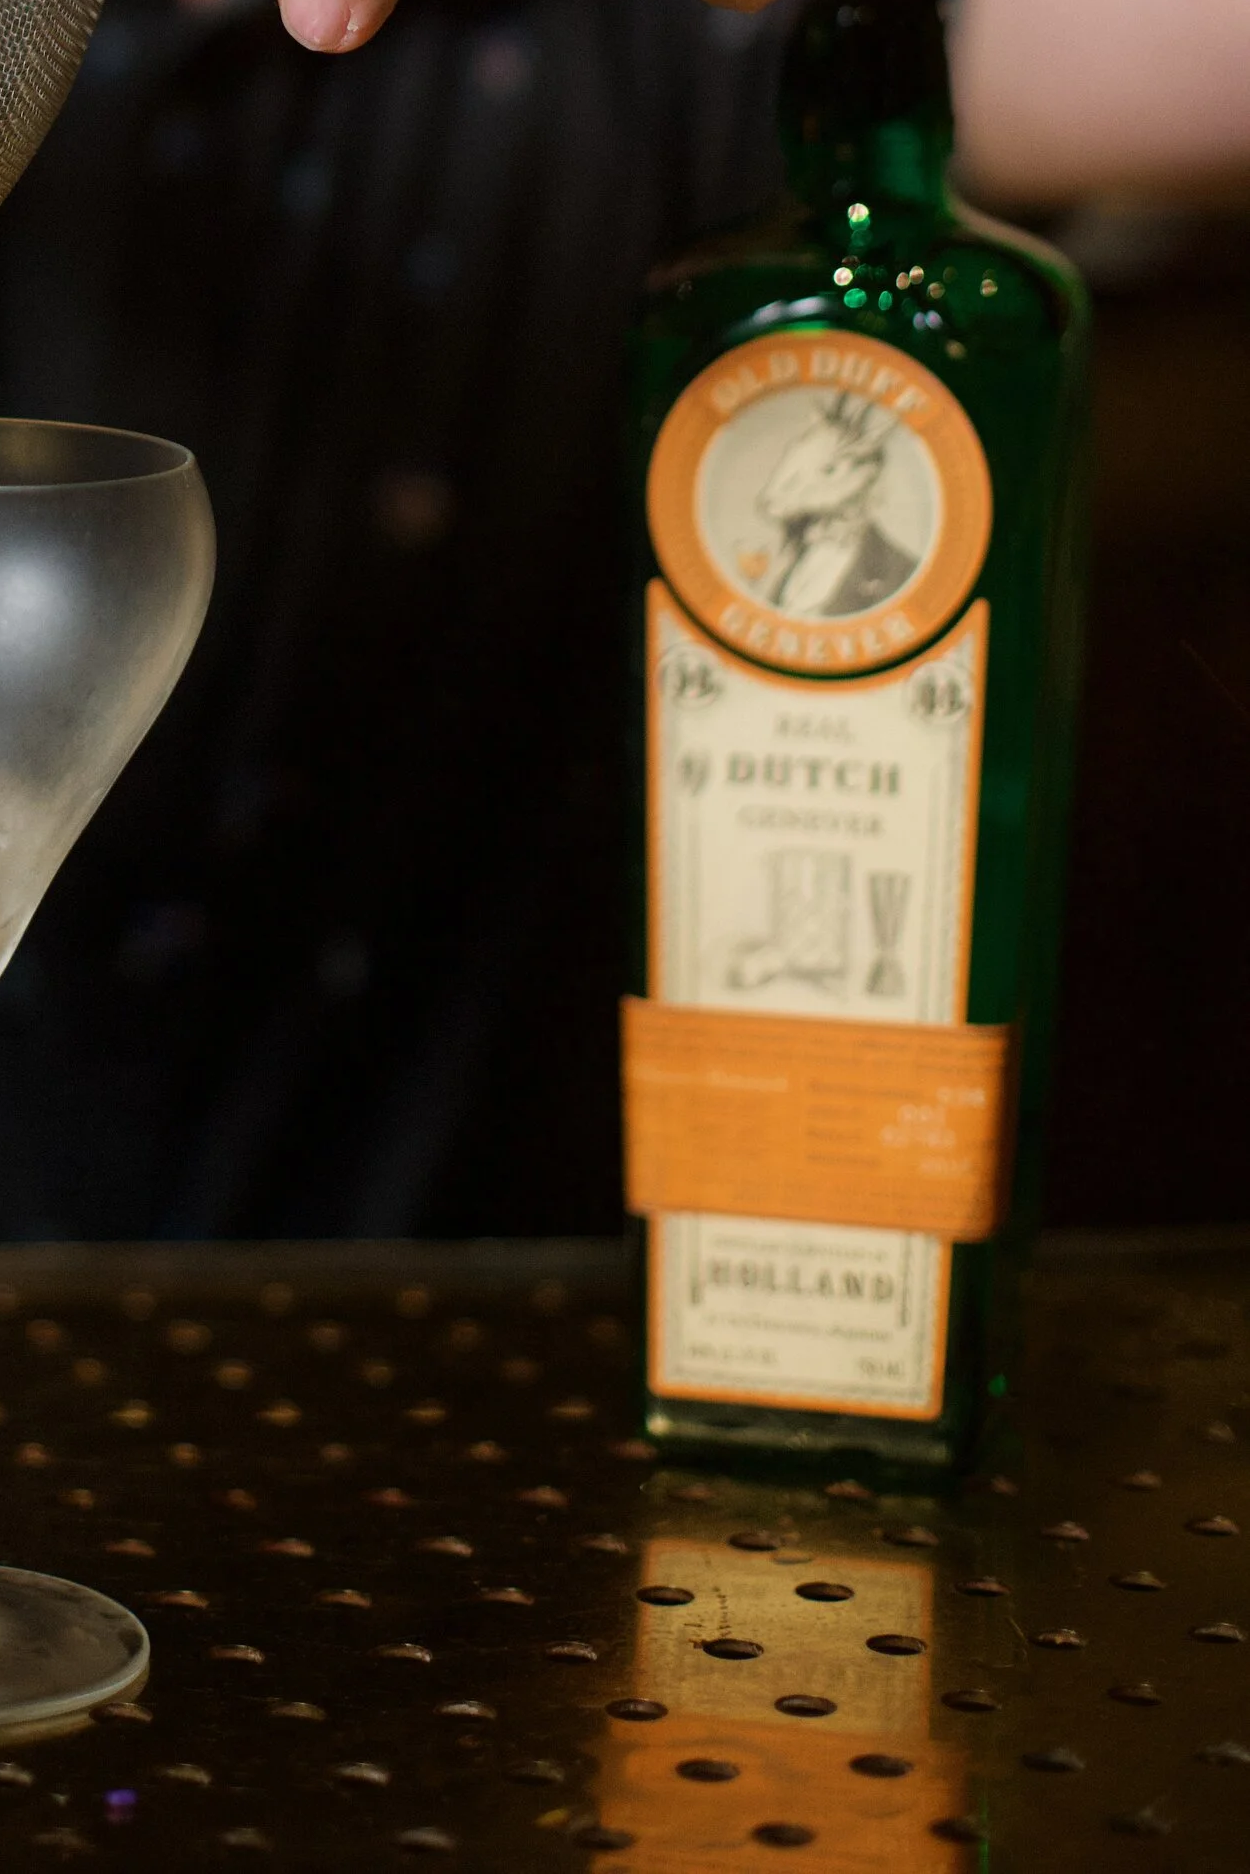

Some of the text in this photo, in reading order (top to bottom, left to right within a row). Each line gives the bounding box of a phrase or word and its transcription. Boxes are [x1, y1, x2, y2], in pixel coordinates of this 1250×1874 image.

[710, 349, 799, 412] OLD
[725, 749, 901, 796] DUTCH
[707, 1256, 896, 1304] HOLLAND
